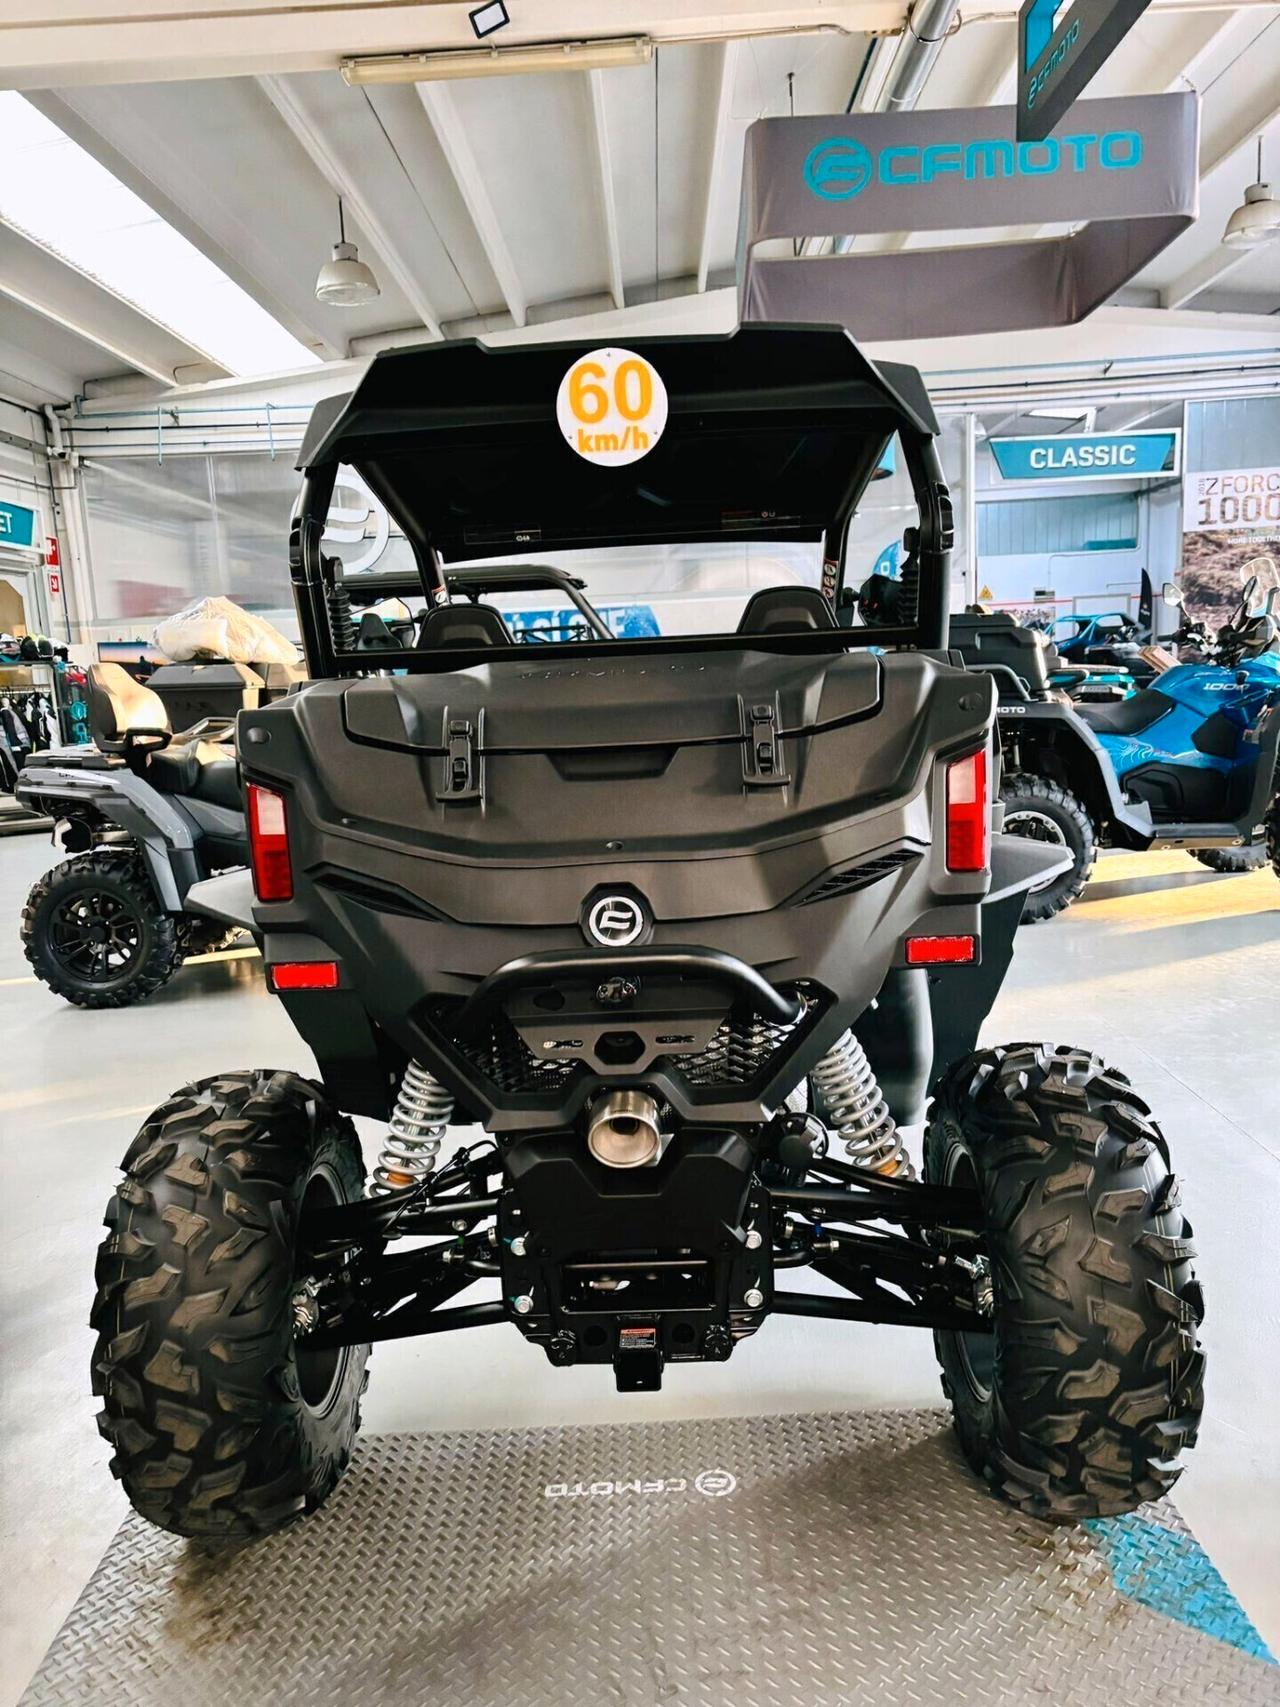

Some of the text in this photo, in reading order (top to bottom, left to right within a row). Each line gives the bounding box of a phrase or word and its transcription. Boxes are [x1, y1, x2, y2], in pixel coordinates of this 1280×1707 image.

[1038, 19, 1080, 92] CFMOTO
[878, 130, 1143, 186] CFMOTO
[569, 360, 652, 424] 60
[577, 426, 649, 453] km/h
[1030, 444, 1136, 469] CLASSIC
[1198, 493, 1280, 526] 1000
[544, 1477, 687, 1498] CFMOTO
